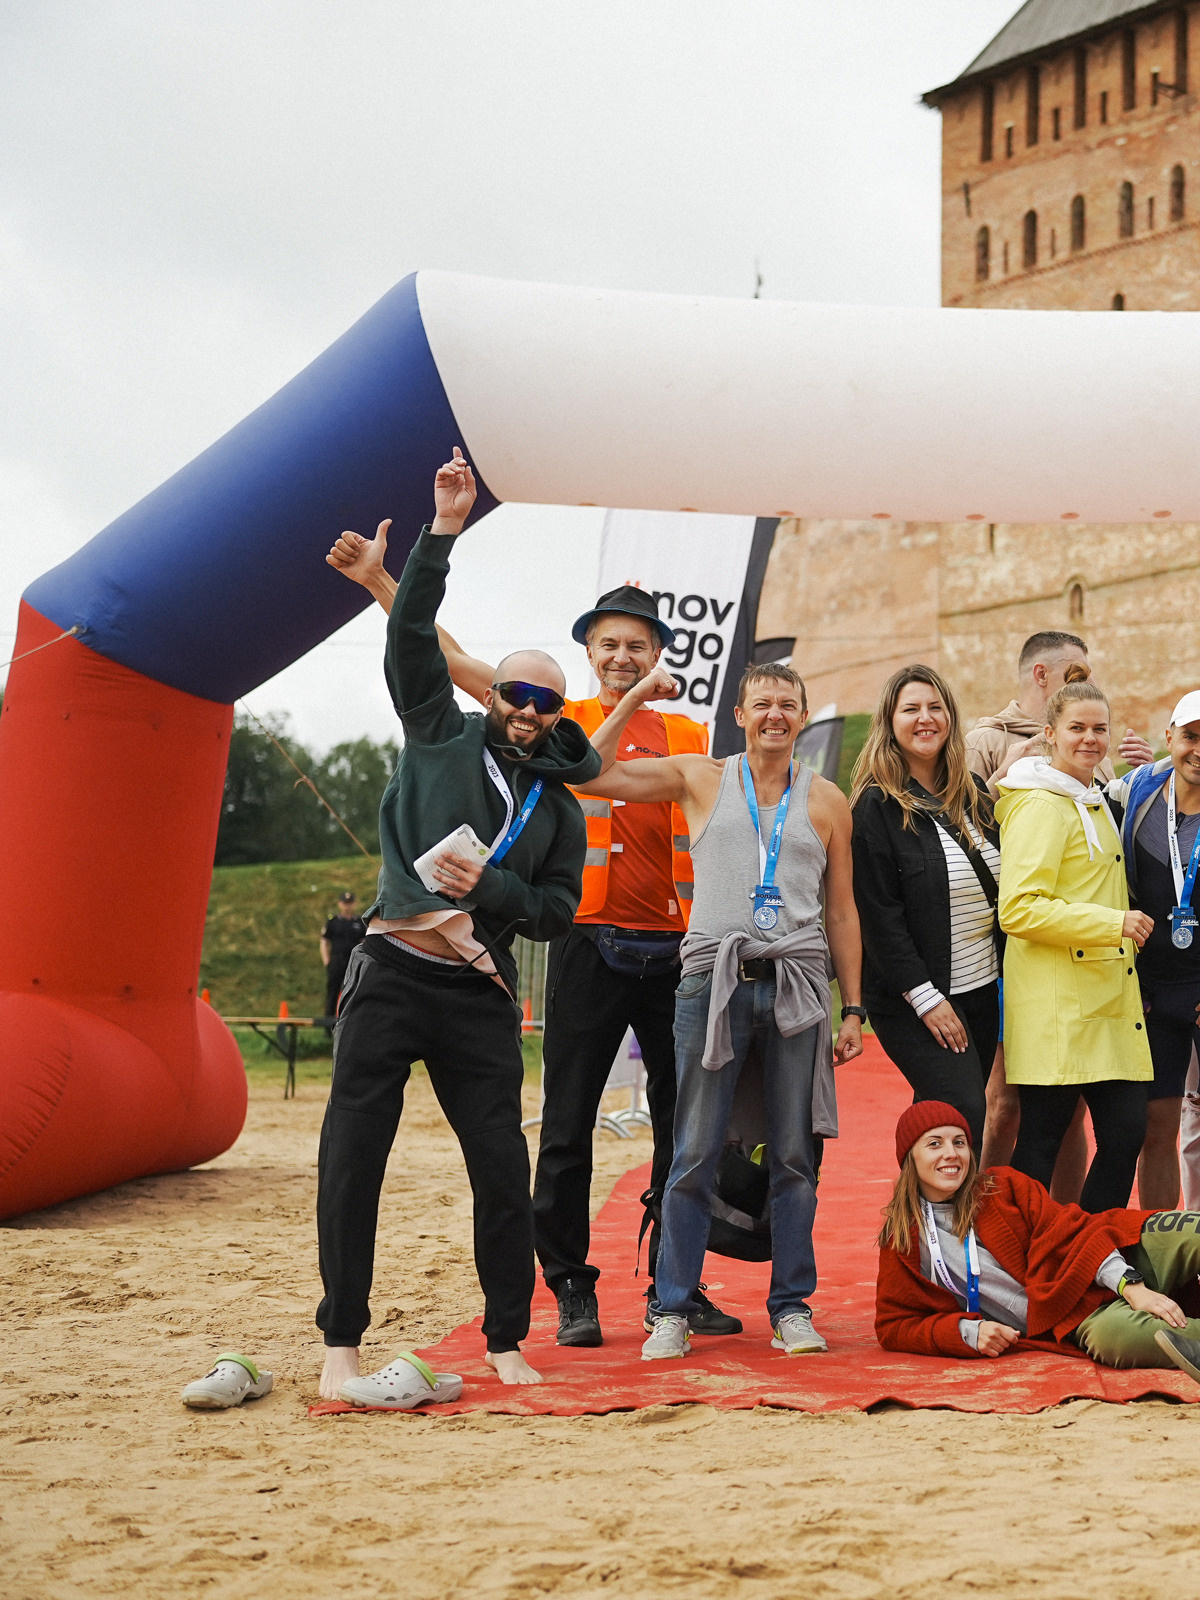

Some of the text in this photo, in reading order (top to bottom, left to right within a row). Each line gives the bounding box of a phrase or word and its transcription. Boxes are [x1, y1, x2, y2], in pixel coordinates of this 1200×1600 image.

[625, 581, 735, 626] nov
[665, 628, 724, 669] go
[666, 664, 720, 706] od
[488, 765, 499, 778] 2023
